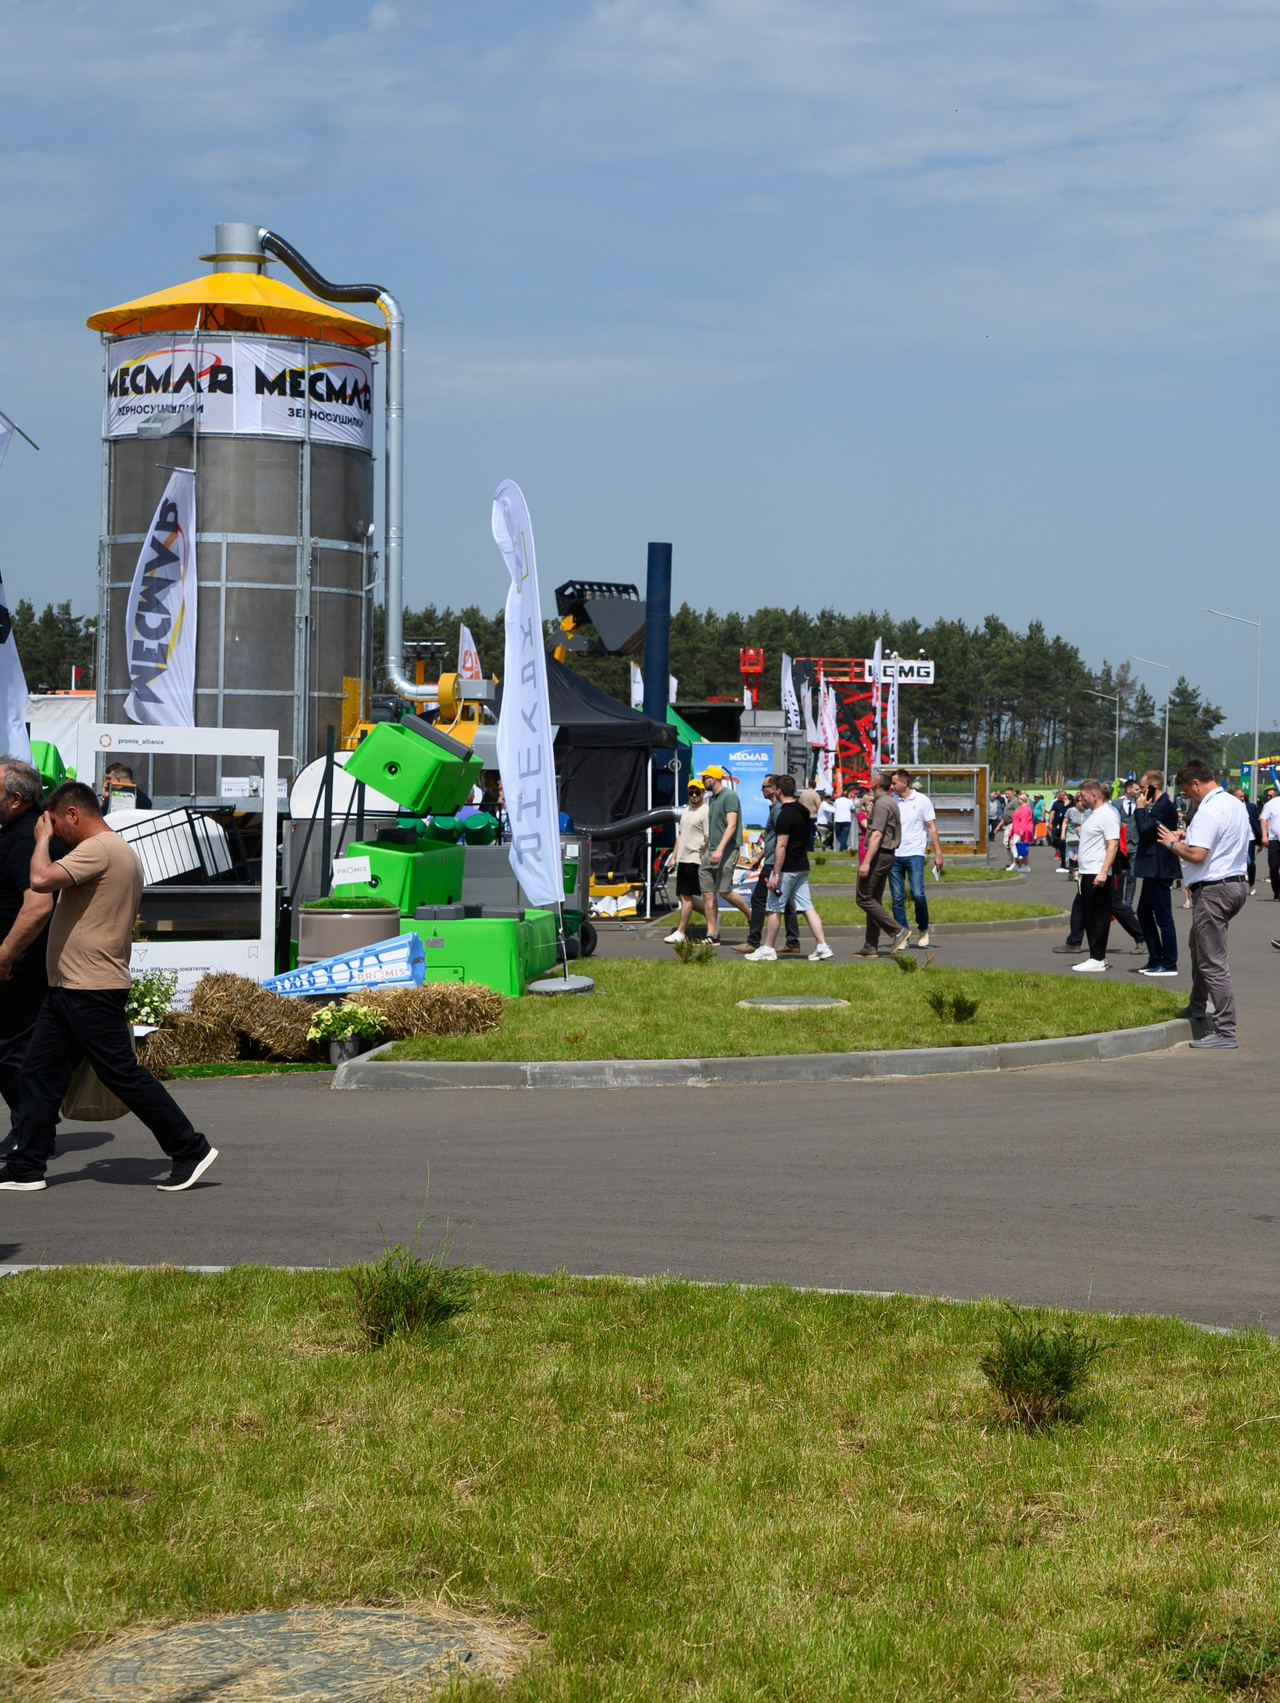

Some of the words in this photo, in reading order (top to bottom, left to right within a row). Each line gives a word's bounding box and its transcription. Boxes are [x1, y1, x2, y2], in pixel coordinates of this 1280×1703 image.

[107, 362, 233, 398] MECMAR
[254, 364, 371, 415] MECMAR
[130, 497, 181, 705] MECMAR
[118, 737, 165, 746] promis_alliance
[1242, 781, 1250, 790] N
[336, 866, 367, 874] PROMIS
[357, 967, 406, 982] PROMIS
